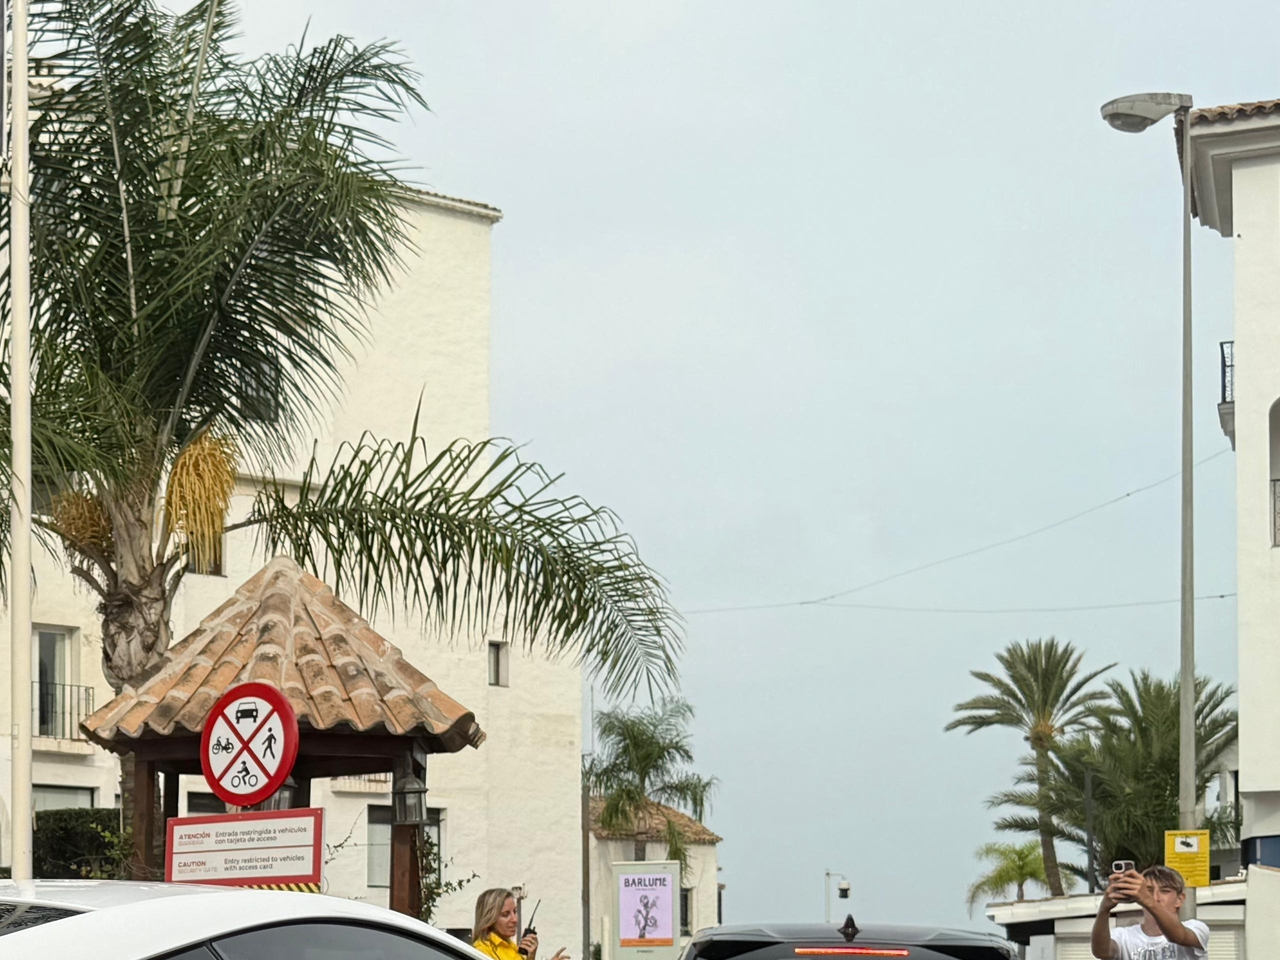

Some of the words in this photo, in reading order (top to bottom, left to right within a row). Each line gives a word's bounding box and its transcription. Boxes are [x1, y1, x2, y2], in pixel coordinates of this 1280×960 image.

[178, 831, 210, 840] ATENCIÓN
[239, 829, 272, 838] restringida
[227, 837, 246, 845] tarjeta
[224, 857, 239, 865] Entry
[624, 877, 667, 887] BARLUME
